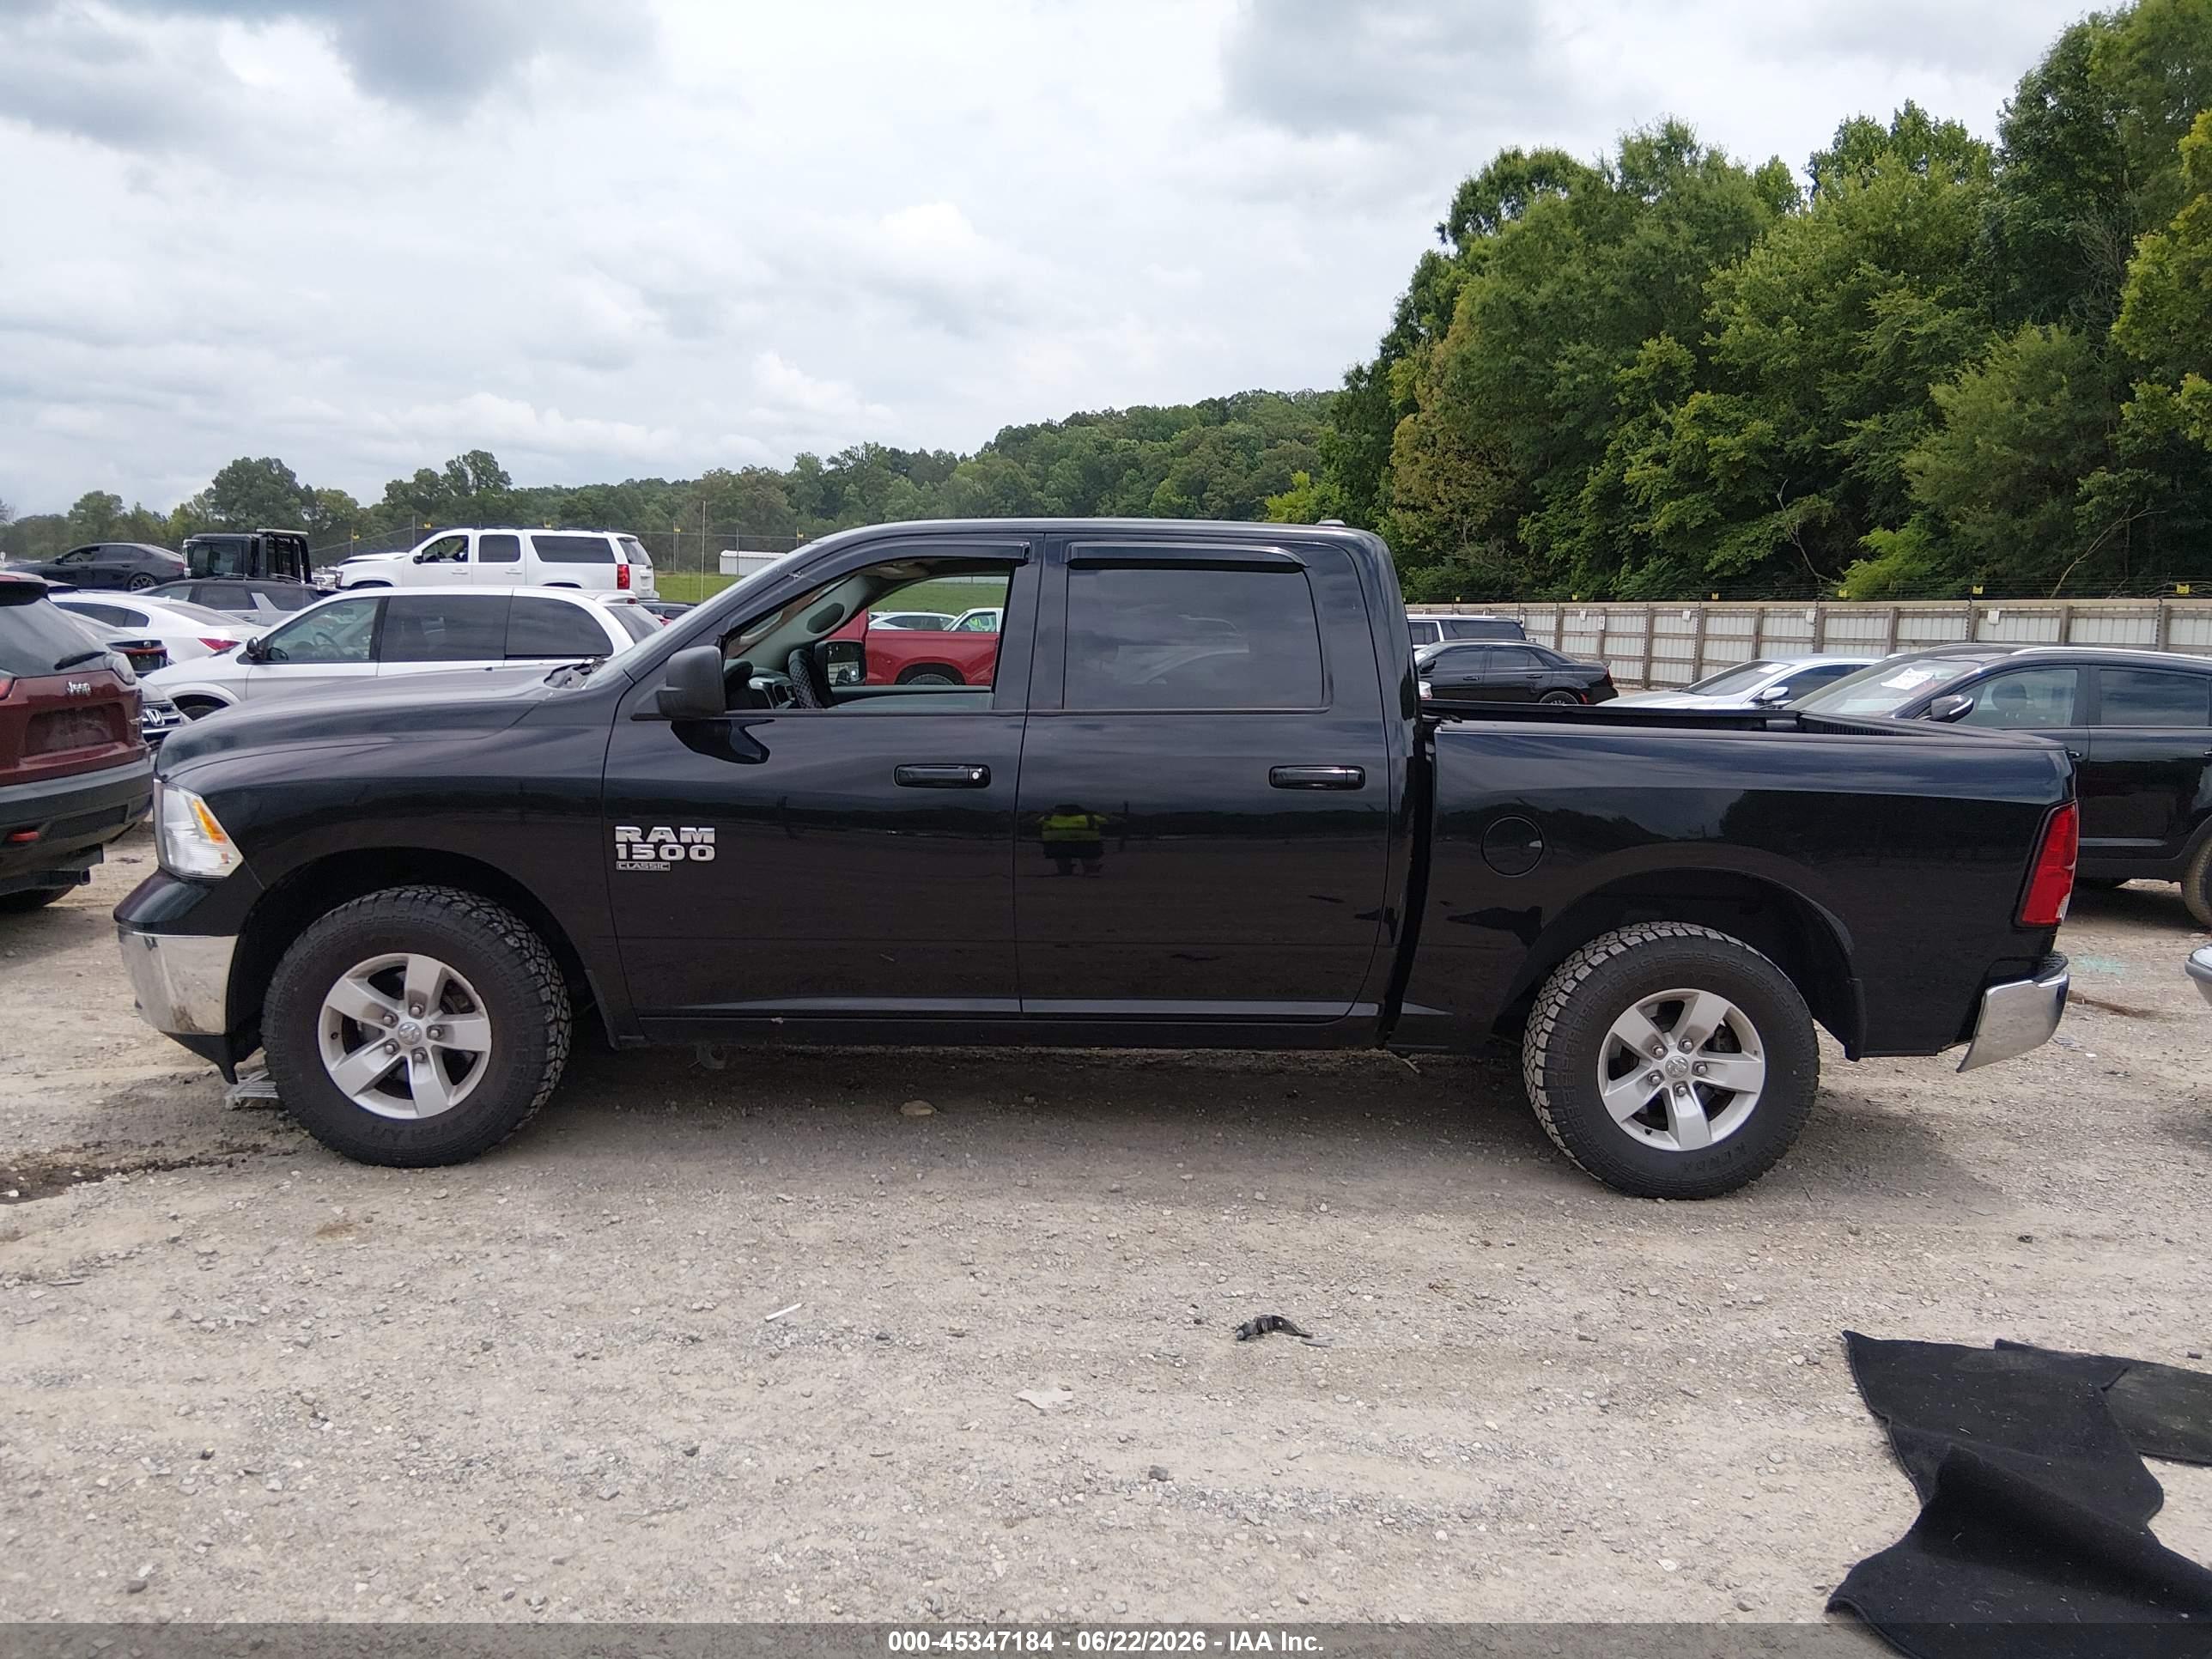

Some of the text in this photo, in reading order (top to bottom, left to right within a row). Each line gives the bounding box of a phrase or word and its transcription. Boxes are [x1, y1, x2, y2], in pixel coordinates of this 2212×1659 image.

[615, 826, 715, 843] RAM
[615, 843, 715, 861] 1500
[616, 861, 671, 871] CLASSIC
